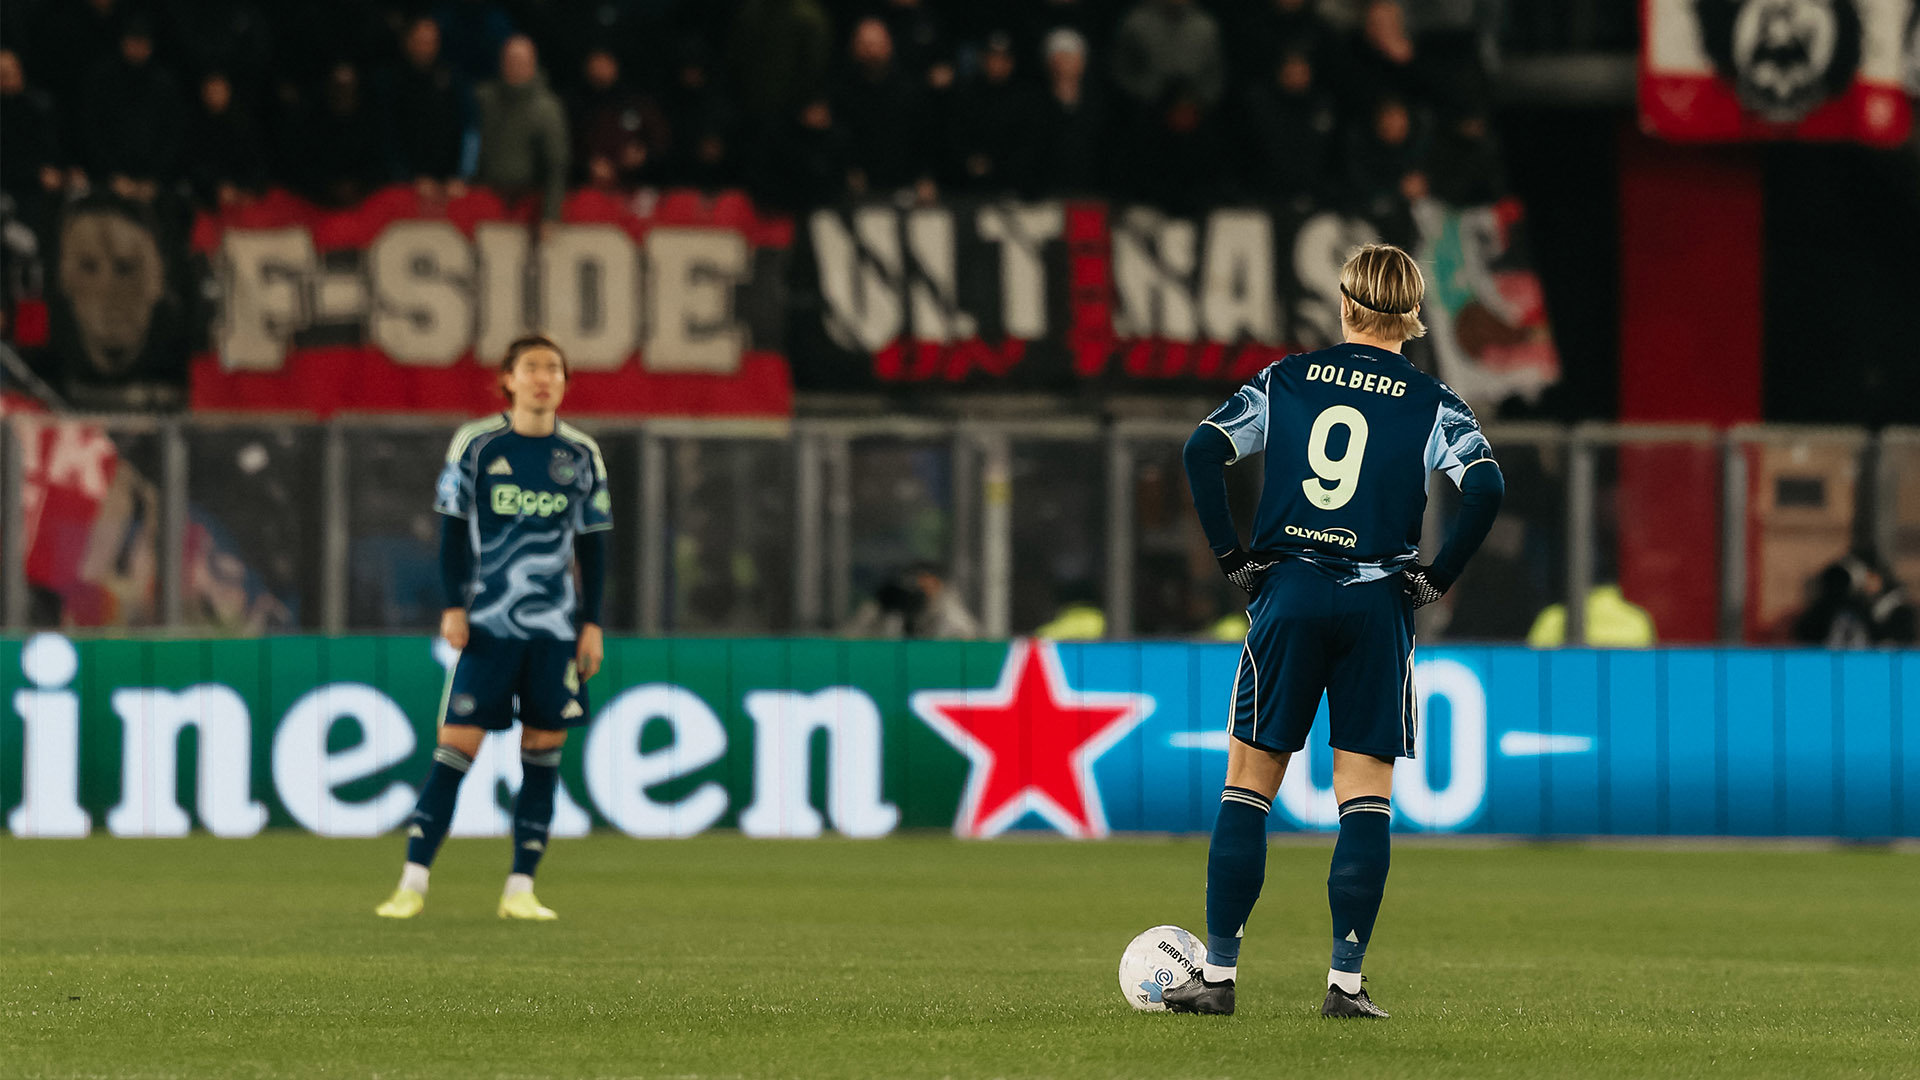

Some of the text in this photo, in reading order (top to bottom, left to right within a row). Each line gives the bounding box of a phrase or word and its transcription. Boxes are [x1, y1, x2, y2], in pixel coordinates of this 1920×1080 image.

[220, 221, 750, 373] F-SIDE
[1306, 363, 1407, 397] DOLBERG
[1302, 404, 1369, 510] 9
[1284, 525, 1357, 549] OLYMPIA
